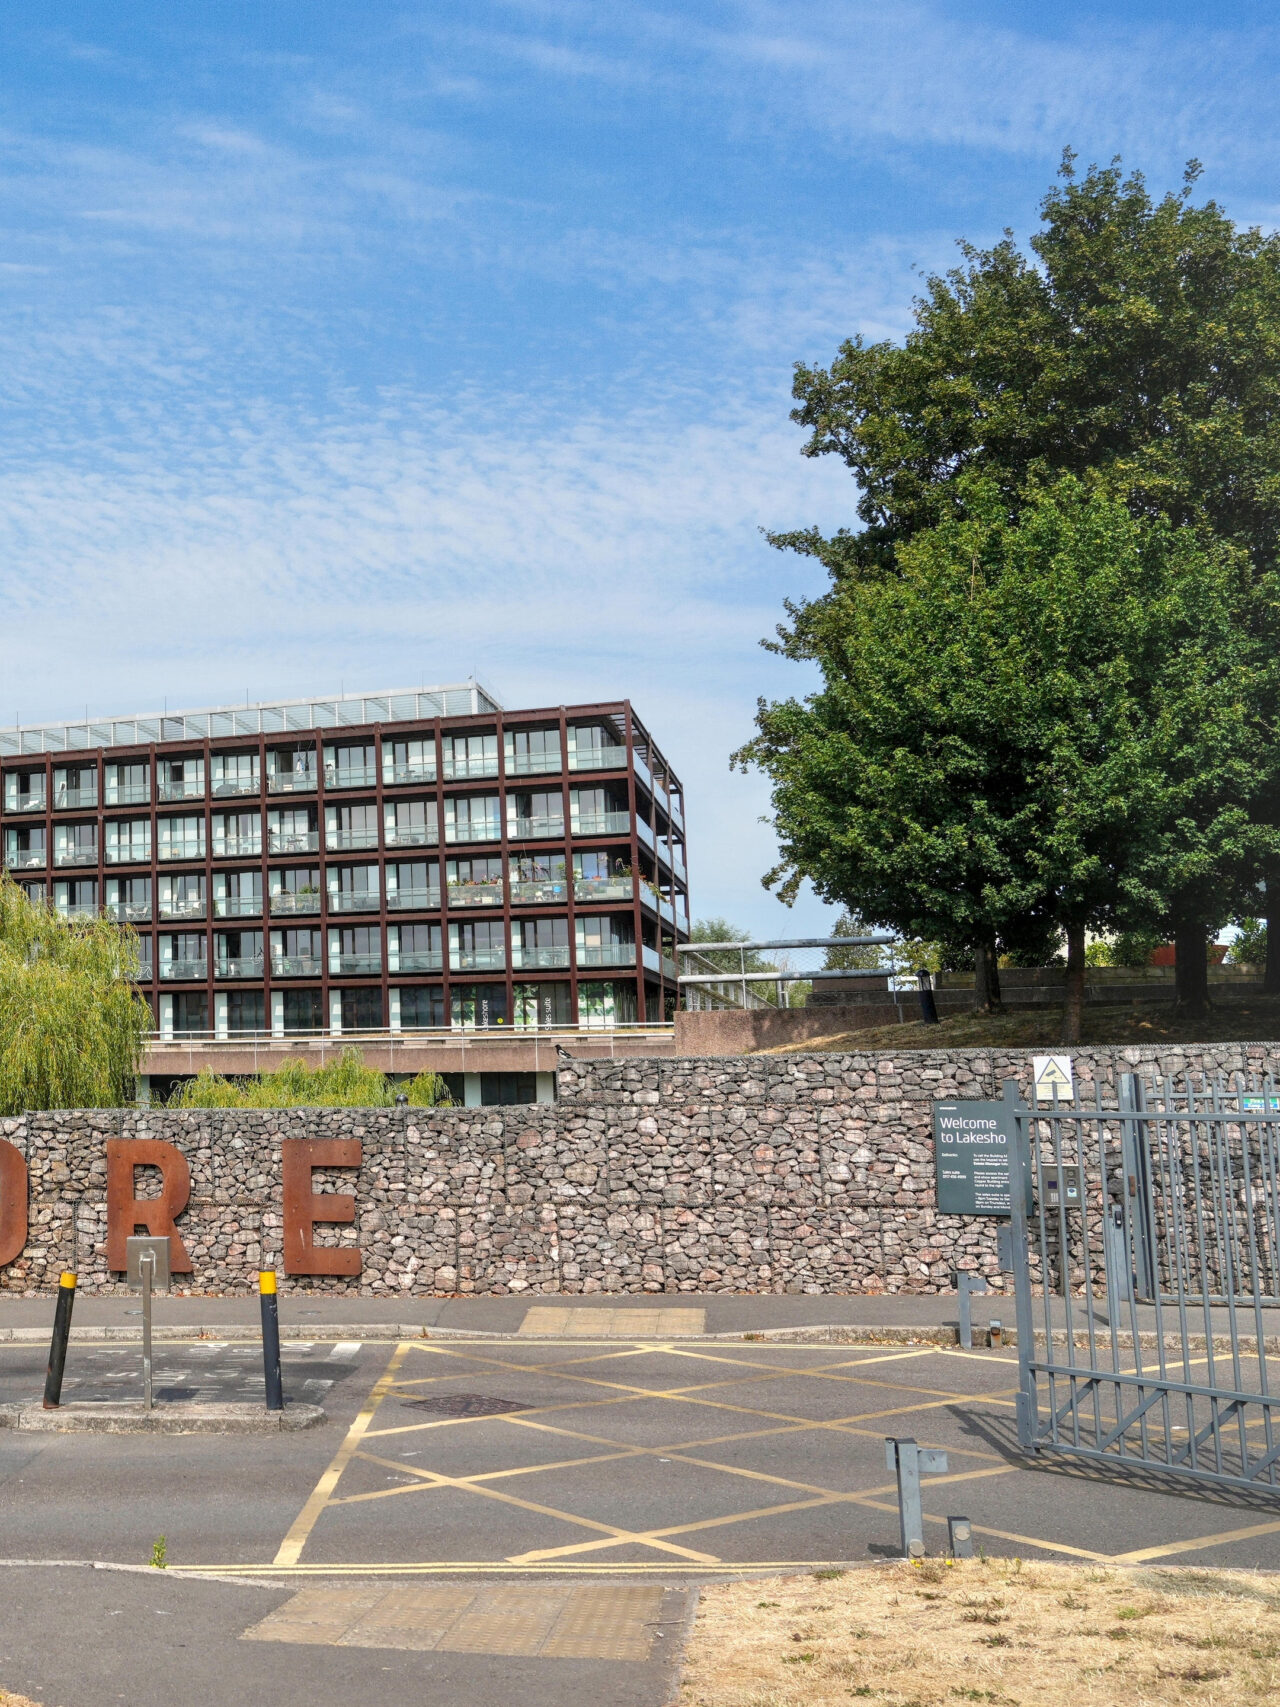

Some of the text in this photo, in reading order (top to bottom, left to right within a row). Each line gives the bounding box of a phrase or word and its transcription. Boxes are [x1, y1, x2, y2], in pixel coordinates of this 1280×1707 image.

[481, 999, 489, 1032] Lkeshore
[939, 1116, 997, 1130] Welcome
[941, 1131, 1006, 1144] to Lakesho
